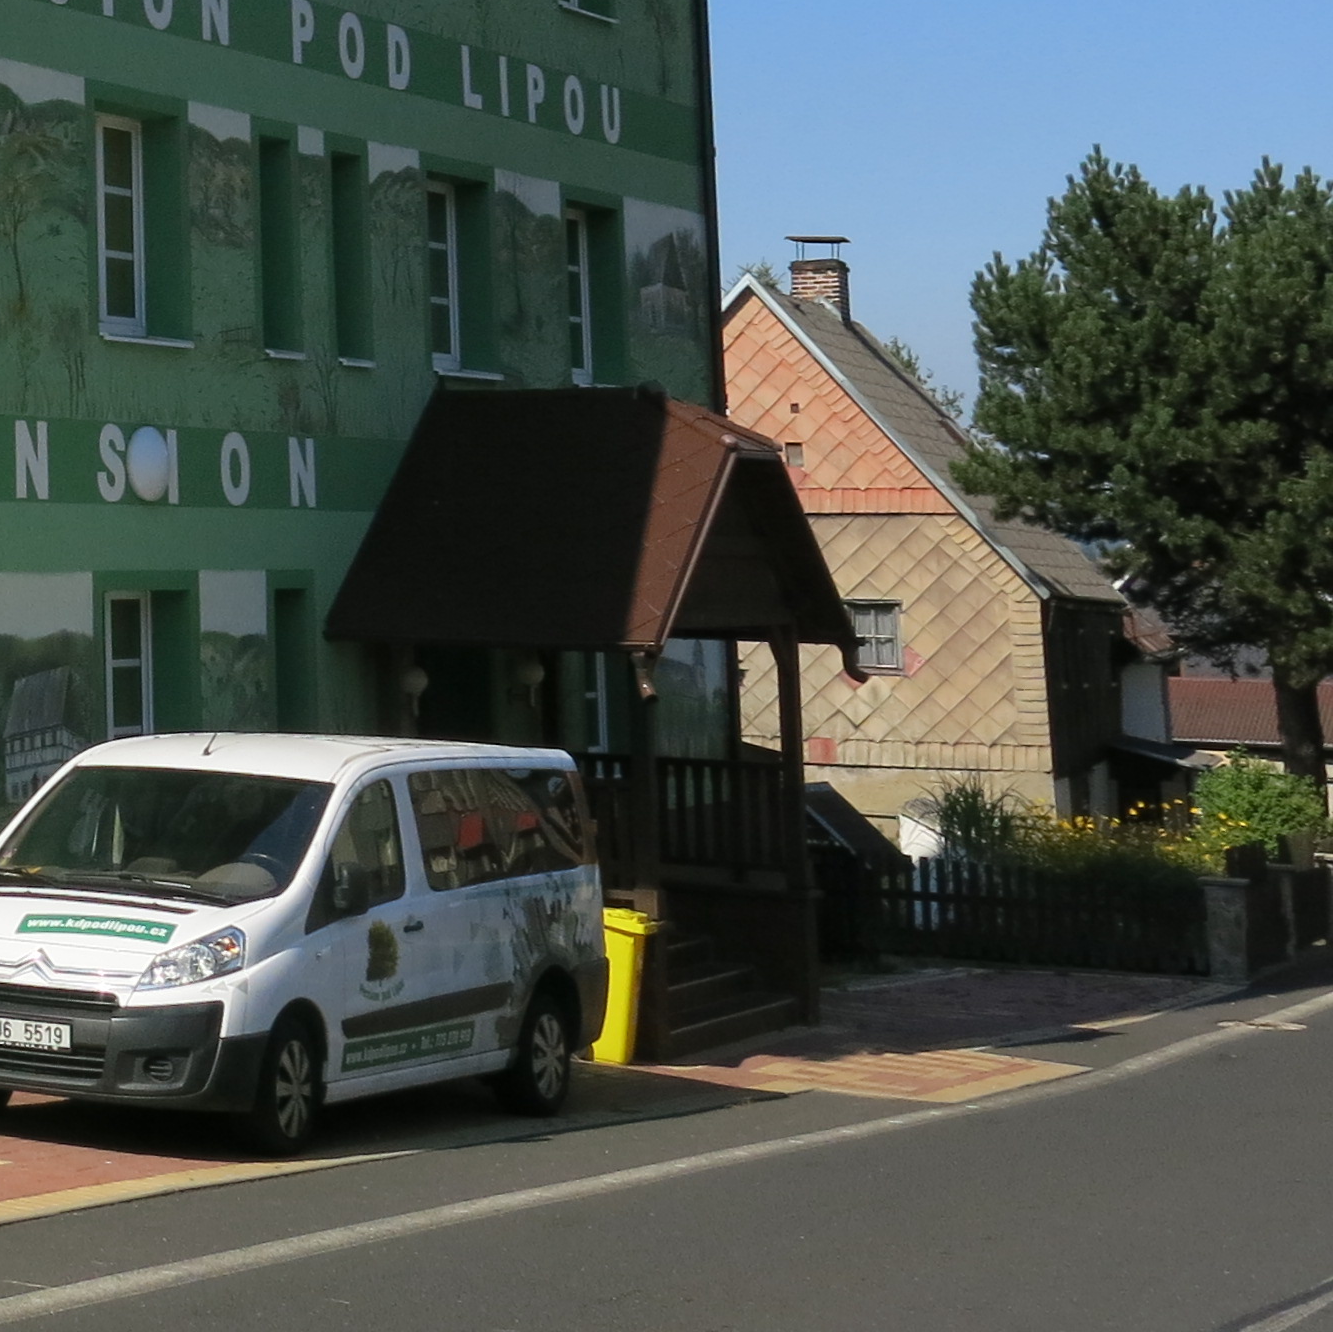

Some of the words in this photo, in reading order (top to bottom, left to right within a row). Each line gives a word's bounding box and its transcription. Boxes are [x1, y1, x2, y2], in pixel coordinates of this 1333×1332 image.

[460, 44, 621, 145] LIPOU
[26, 918, 168, 937] www.kdpodlipou.cz
[24, 1023, 63, 1045] 5519
